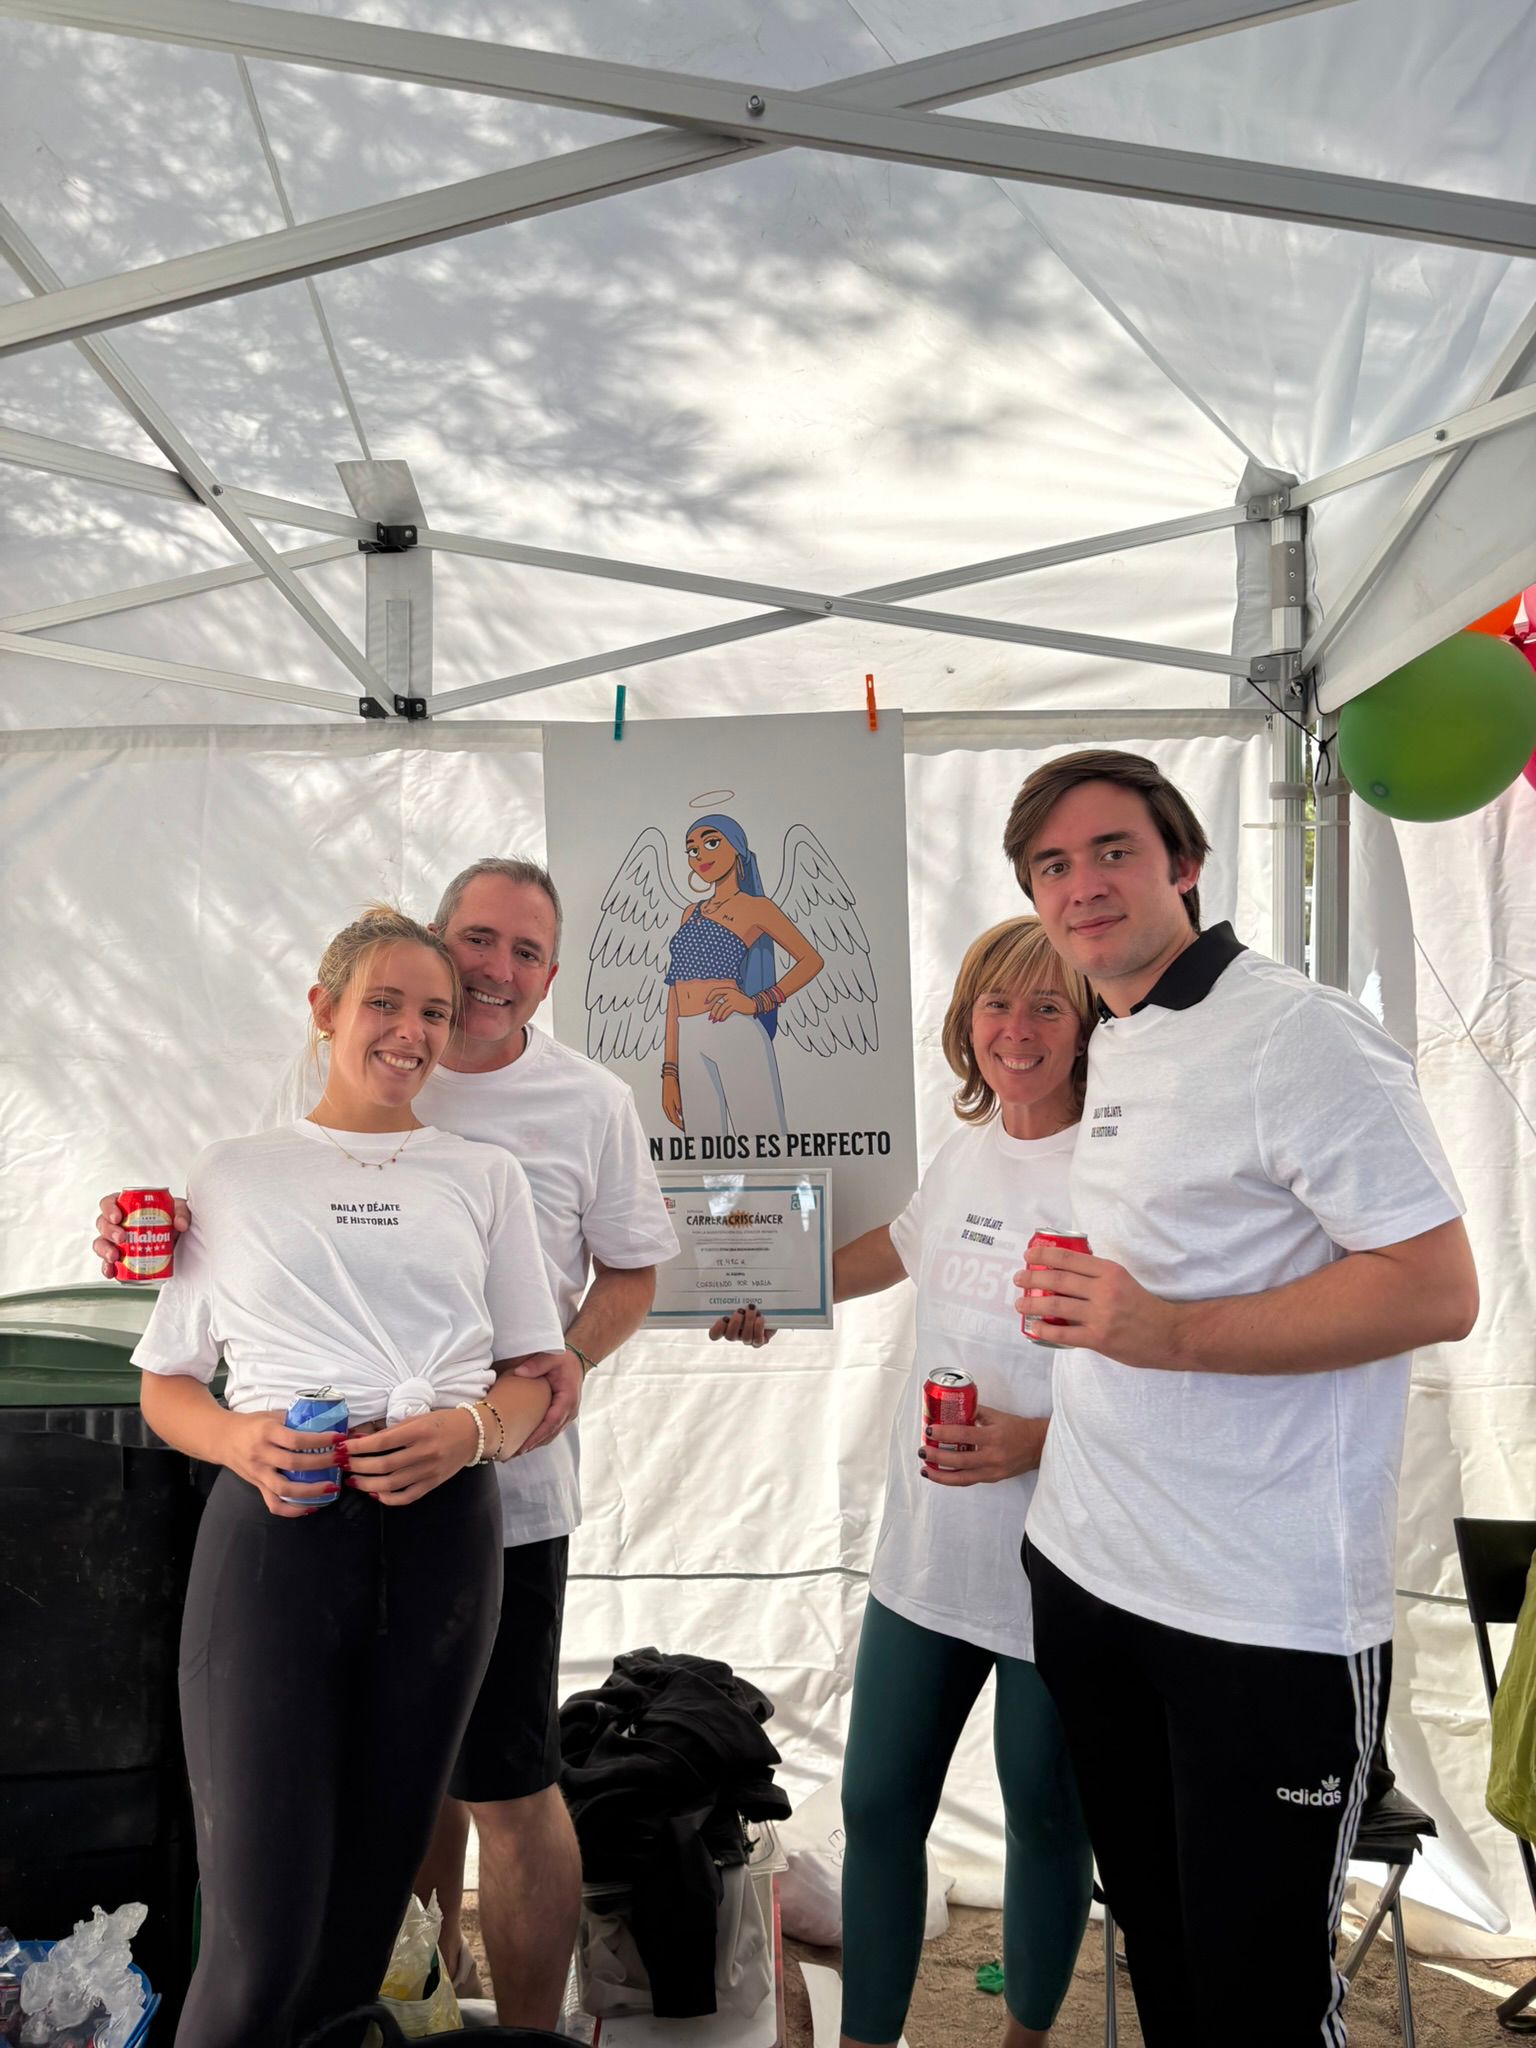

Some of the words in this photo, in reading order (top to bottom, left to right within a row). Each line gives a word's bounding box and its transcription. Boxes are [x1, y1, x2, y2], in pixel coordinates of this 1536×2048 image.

[670, 1136, 696, 1160] DE
[701, 1134, 751, 1160] DIOS
[756, 1133, 782, 1158] ES
[787, 1131, 891, 1157] PERFECTO
[330, 1203, 357, 1212] BAILA
[358, 1204, 365, 1212] Y
[367, 1201, 401, 1212] DÉJATE
[336, 1215, 348, 1224] DE
[350, 1216, 399, 1226] HISTORIAS
[961, 1229, 970, 1239] DE
[968, 1231, 995, 1246] HISTORIAS
[1276, 1786, 1342, 1806] adidas
